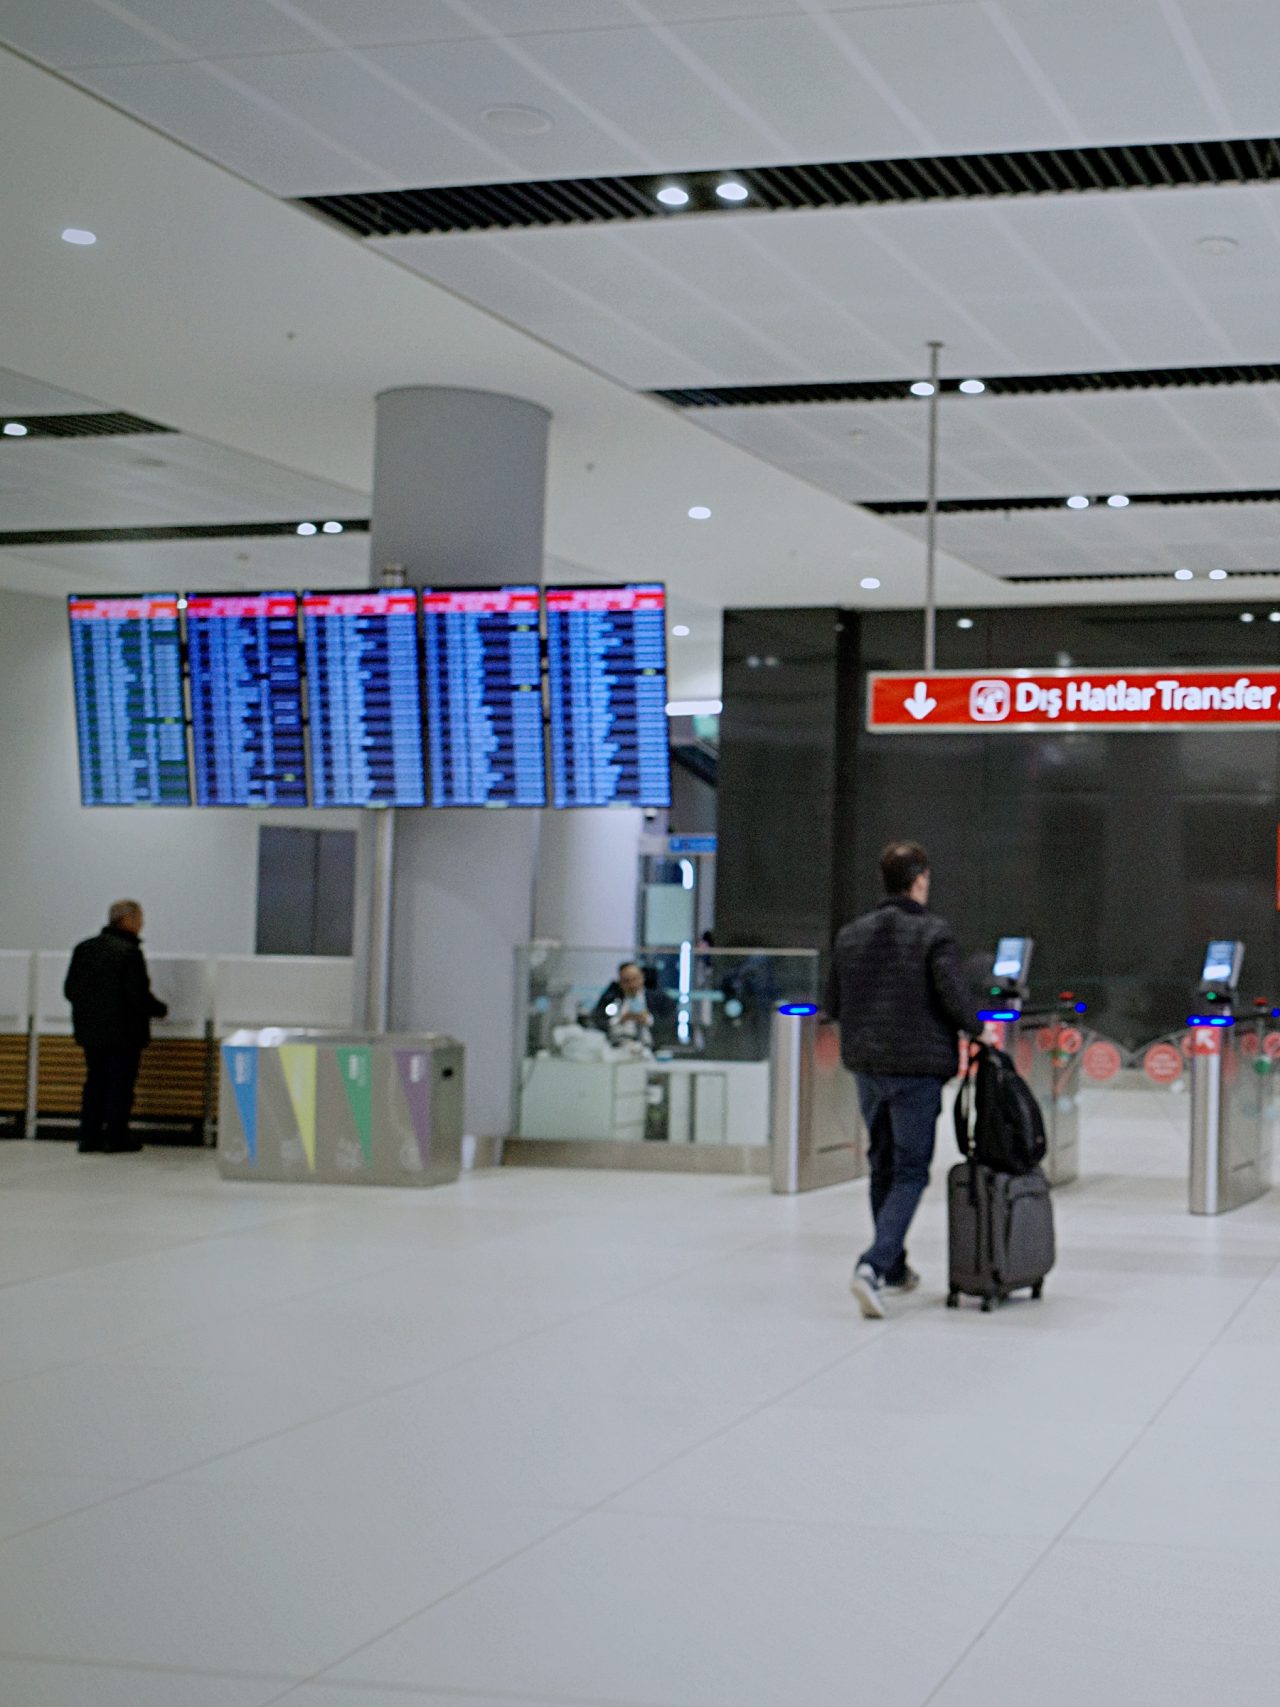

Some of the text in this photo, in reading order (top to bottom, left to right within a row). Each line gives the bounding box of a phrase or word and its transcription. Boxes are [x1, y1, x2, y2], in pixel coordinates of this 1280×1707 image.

[1015, 682, 1062, 718] Dış
[1066, 680, 1155, 711] Hatlar
[1156, 679, 1276, 710] Transfer
